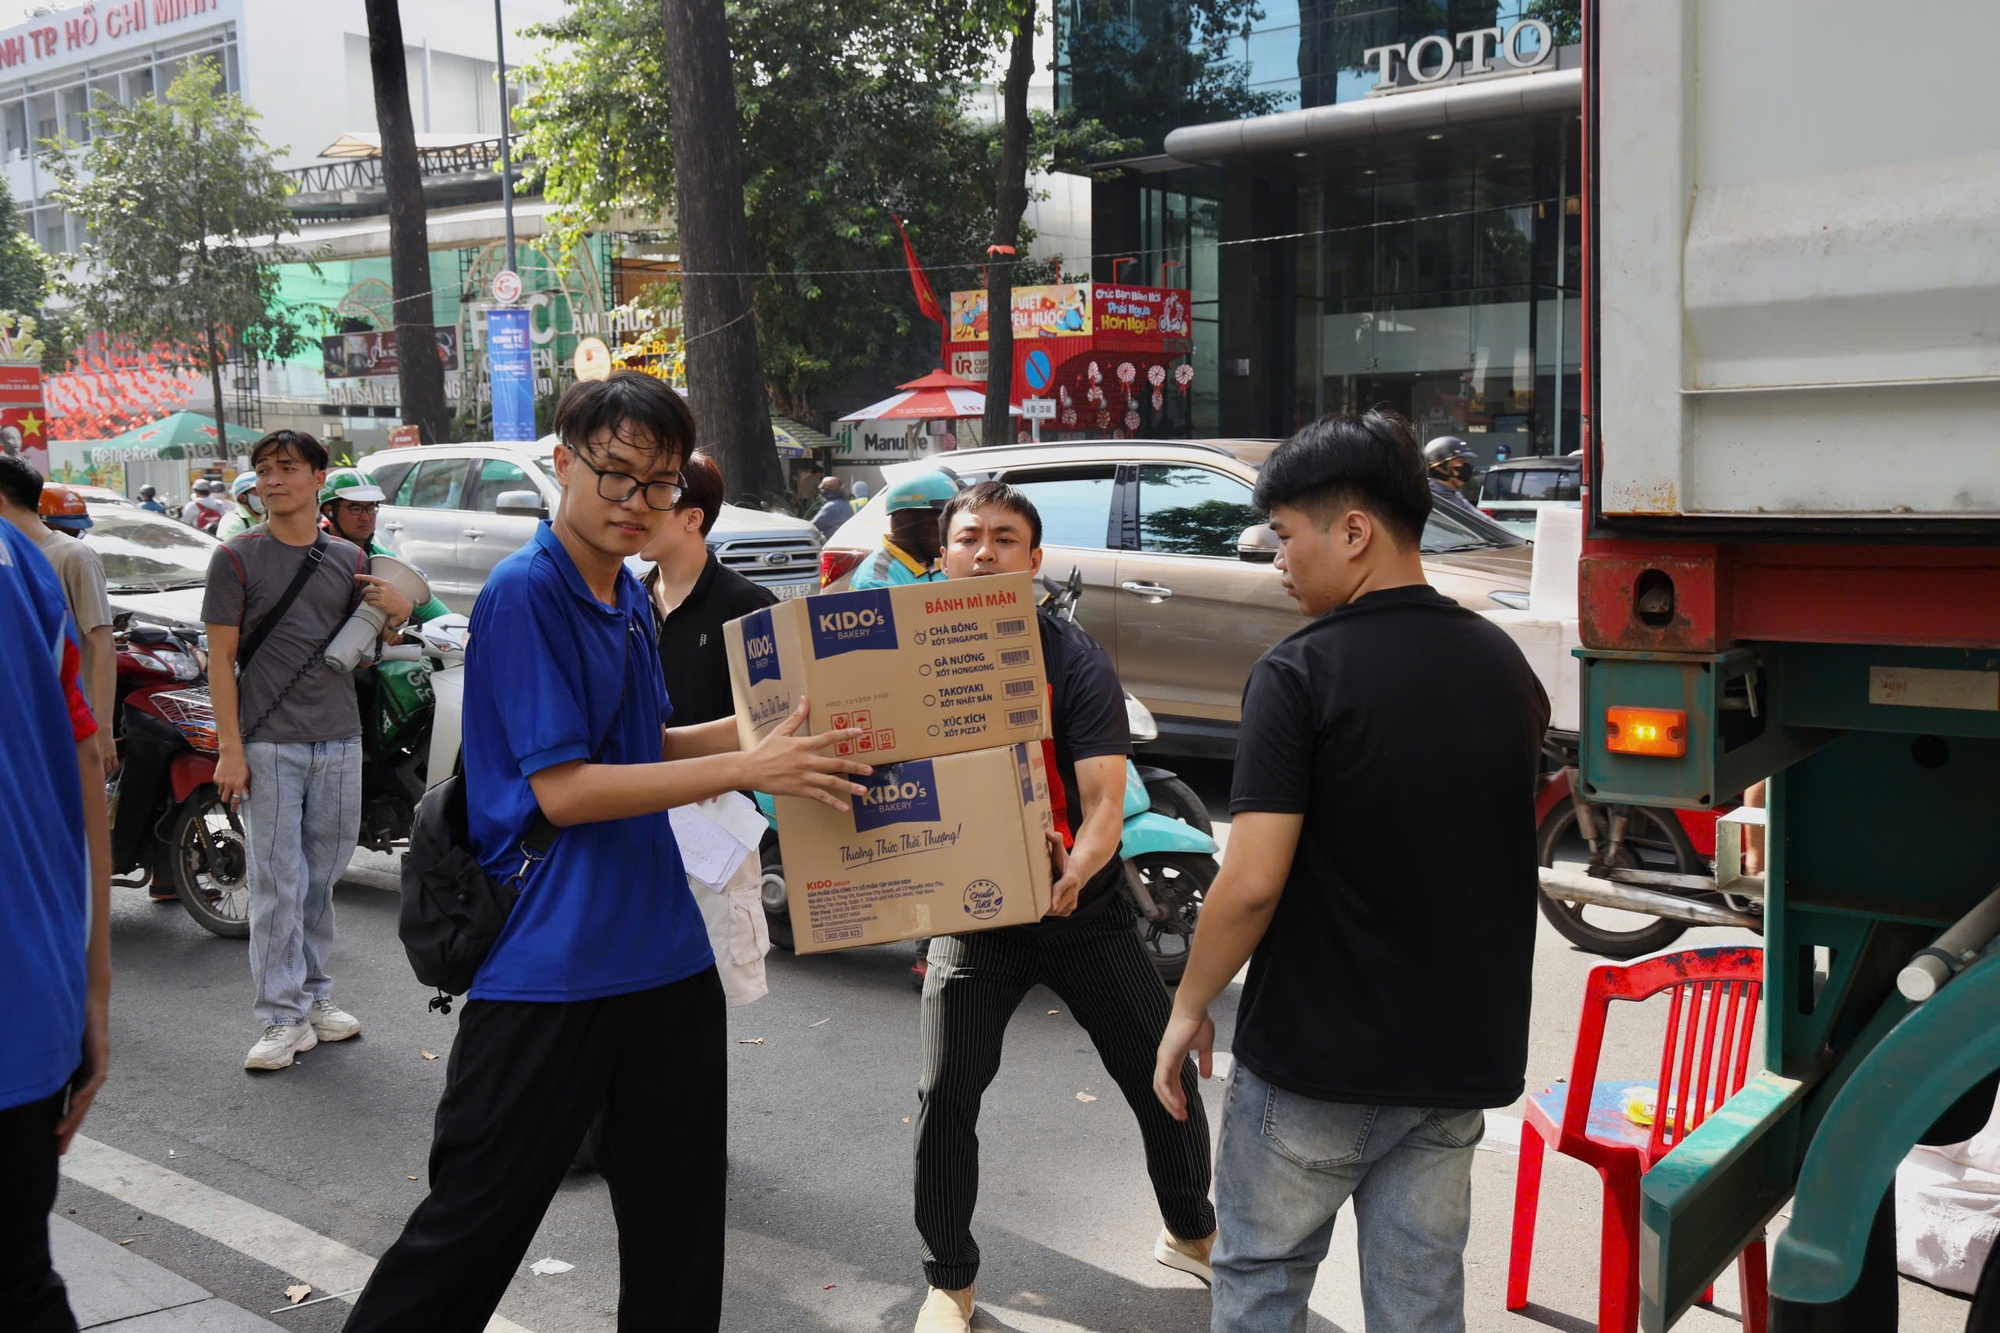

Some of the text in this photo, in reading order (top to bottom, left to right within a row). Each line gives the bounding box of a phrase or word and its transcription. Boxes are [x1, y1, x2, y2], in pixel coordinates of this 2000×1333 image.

[1363, 18, 1553, 91] TOTO
[91, 447, 158, 463] Heineken
[925, 589, 1017, 614] BÁNH MÌ MẶN
[819, 608, 885, 632] KIDO's
[837, 628, 871, 640] BAKERY
[929, 622, 978, 636] CHÀ BÔNG
[747, 634, 774, 660] KIDO's
[931, 637, 946, 647] XỐT
[947, 632, 988, 645] SINGAPORE
[934, 652, 985, 667] GÀ NƯỚNG
[936, 663, 995, 677] XỐT HONGKONG
[938, 683, 984, 697] TAKOYAKI
[940, 693, 993, 708] XỐT NHẬT BẢN
[942, 713, 986, 728] XÚC XÍCH
[880, 733, 891, 742] 10
[944, 729, 958, 738] XỐT
[960, 727, 981, 736] PIZZA
[862, 781, 927, 806] KIDO's
[878, 801, 912, 813] BAKERY
[806, 880, 832, 890] KIDO
